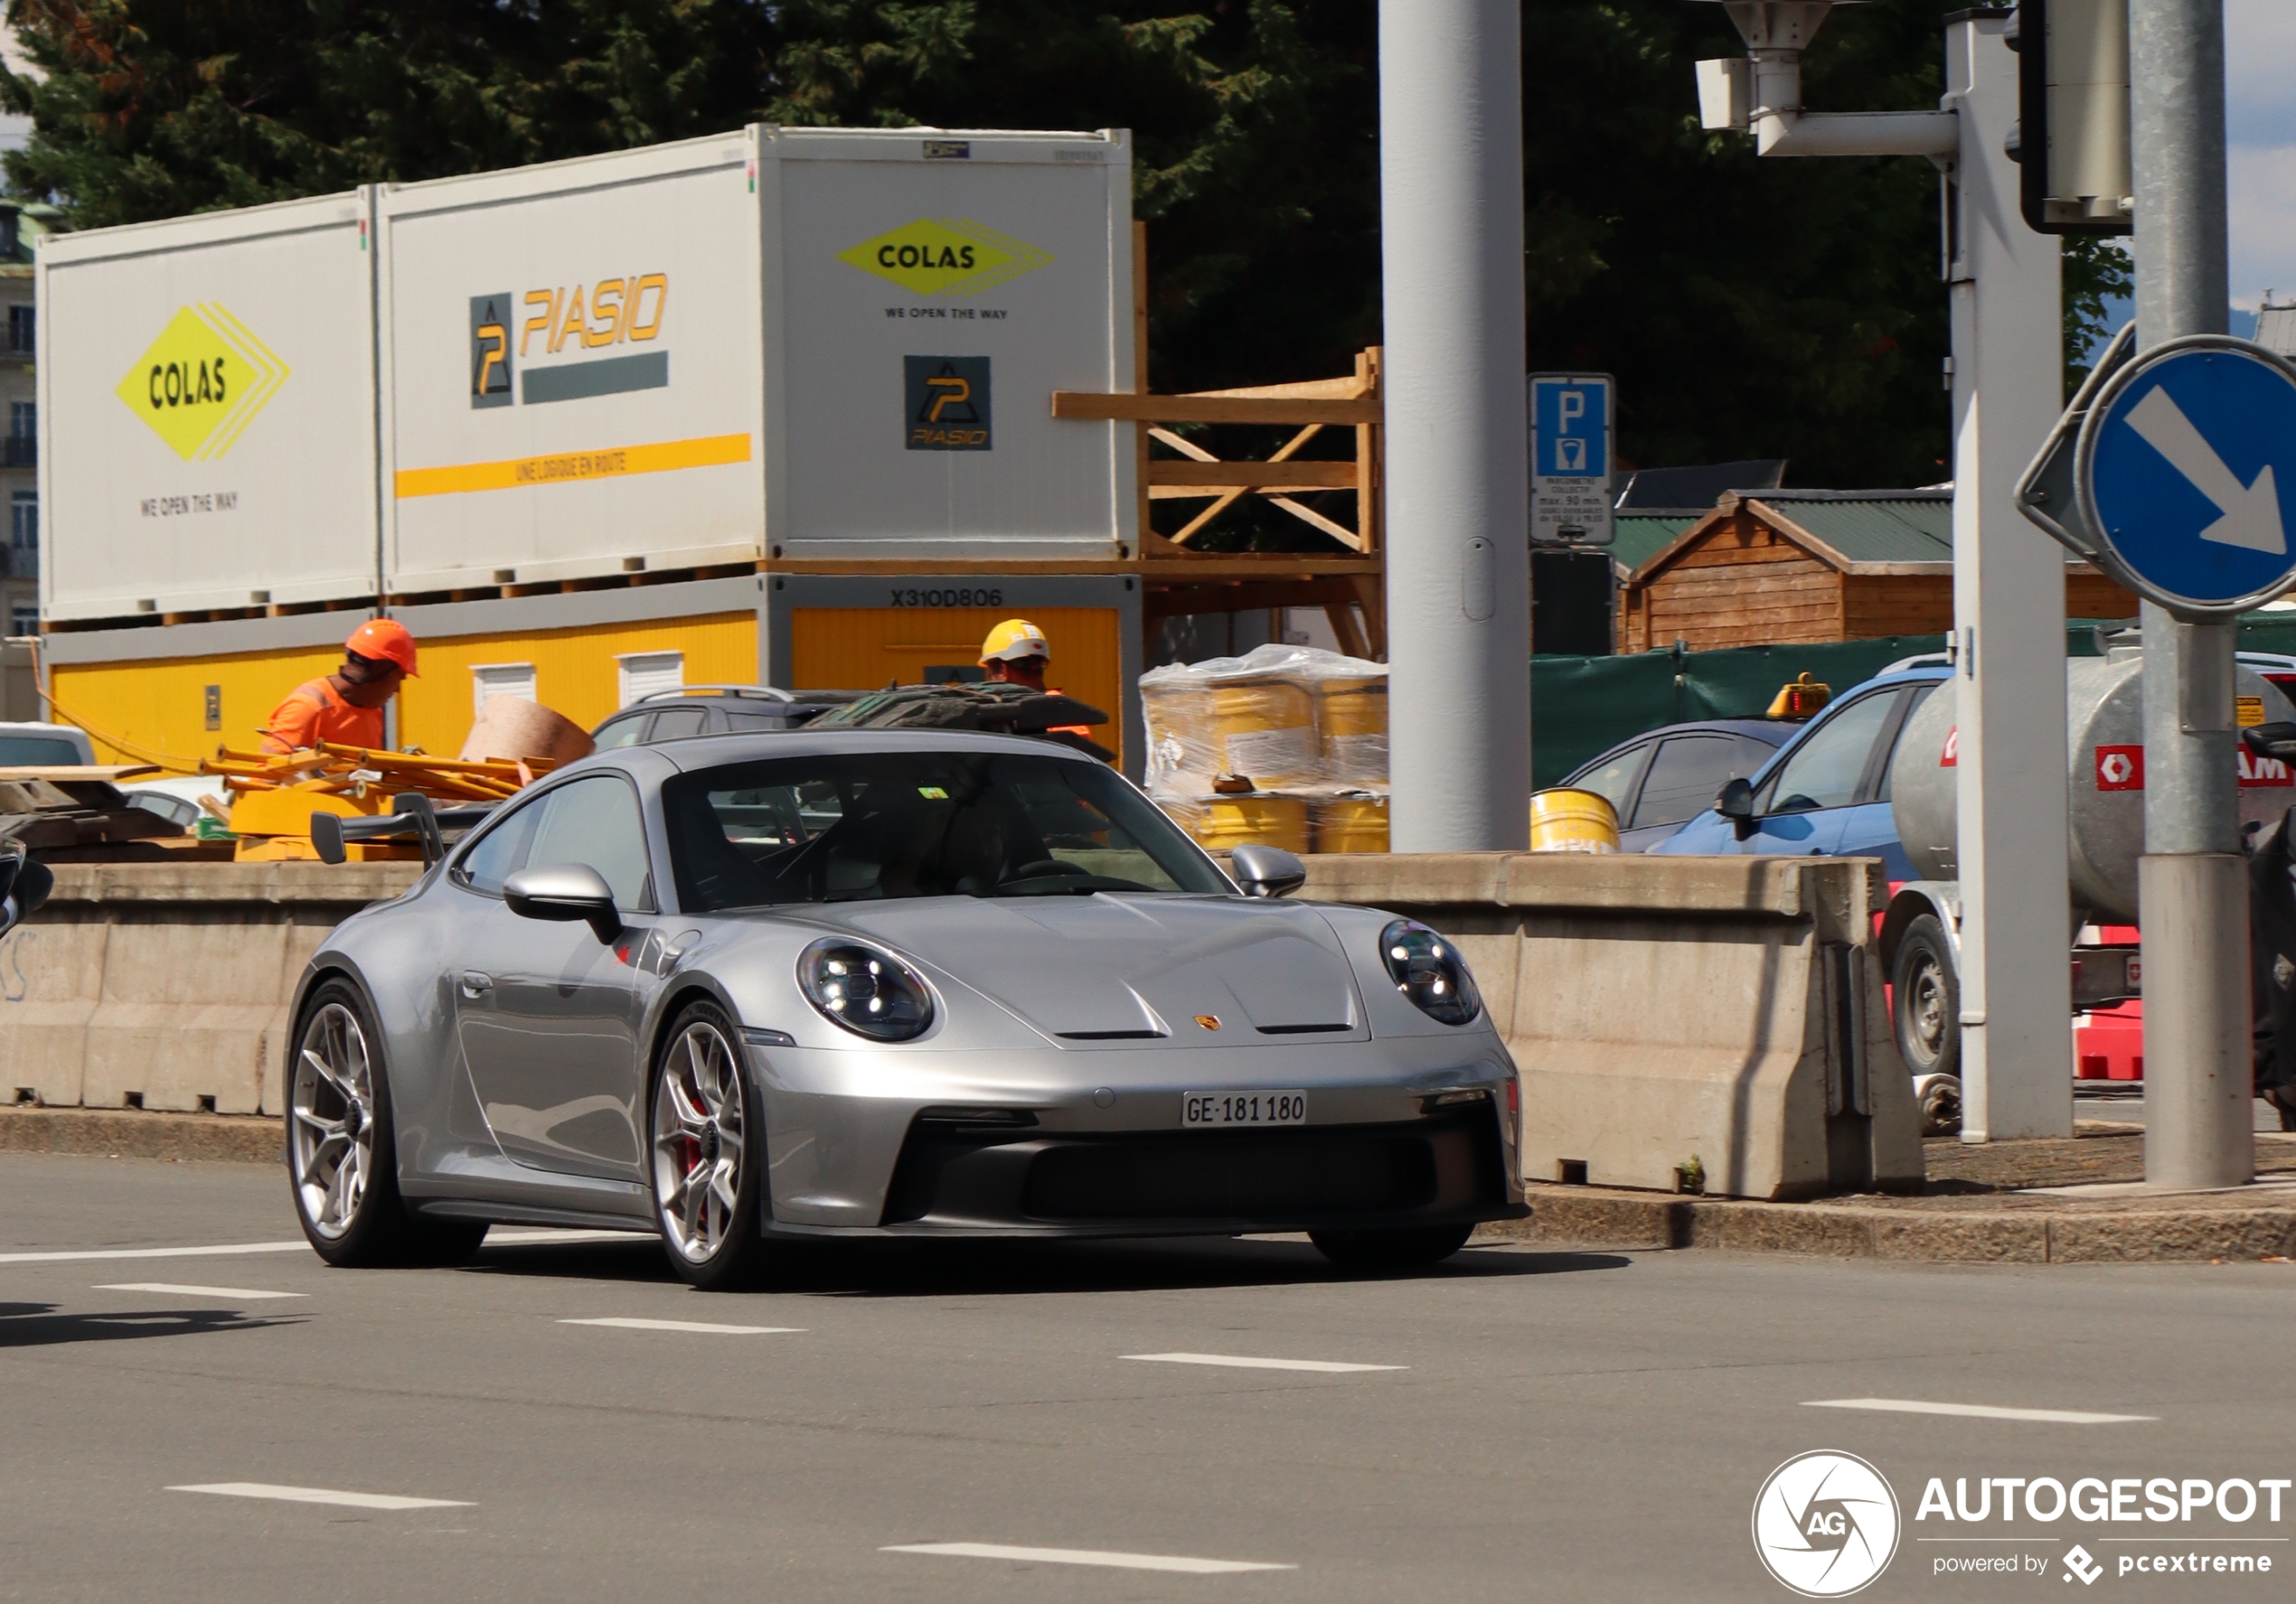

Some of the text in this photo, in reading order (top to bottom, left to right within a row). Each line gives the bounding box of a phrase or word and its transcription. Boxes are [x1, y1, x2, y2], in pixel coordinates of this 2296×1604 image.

[878, 245, 974, 268] COLAS
[519, 272, 668, 356] PIASIO
[885, 307, 1008, 319] WE OPEN THE WAY
[149, 357, 225, 409] COLAS
[1559, 390, 1585, 435] P
[910, 428, 988, 446] PIASIO
[515, 452, 626, 481] UNE LOGIQUE EN ROUTE
[140, 492, 238, 517] WE OPEN THE WAY
[1566, 495, 1580, 505] 90
[1266, 1095, 1304, 1121] 180
